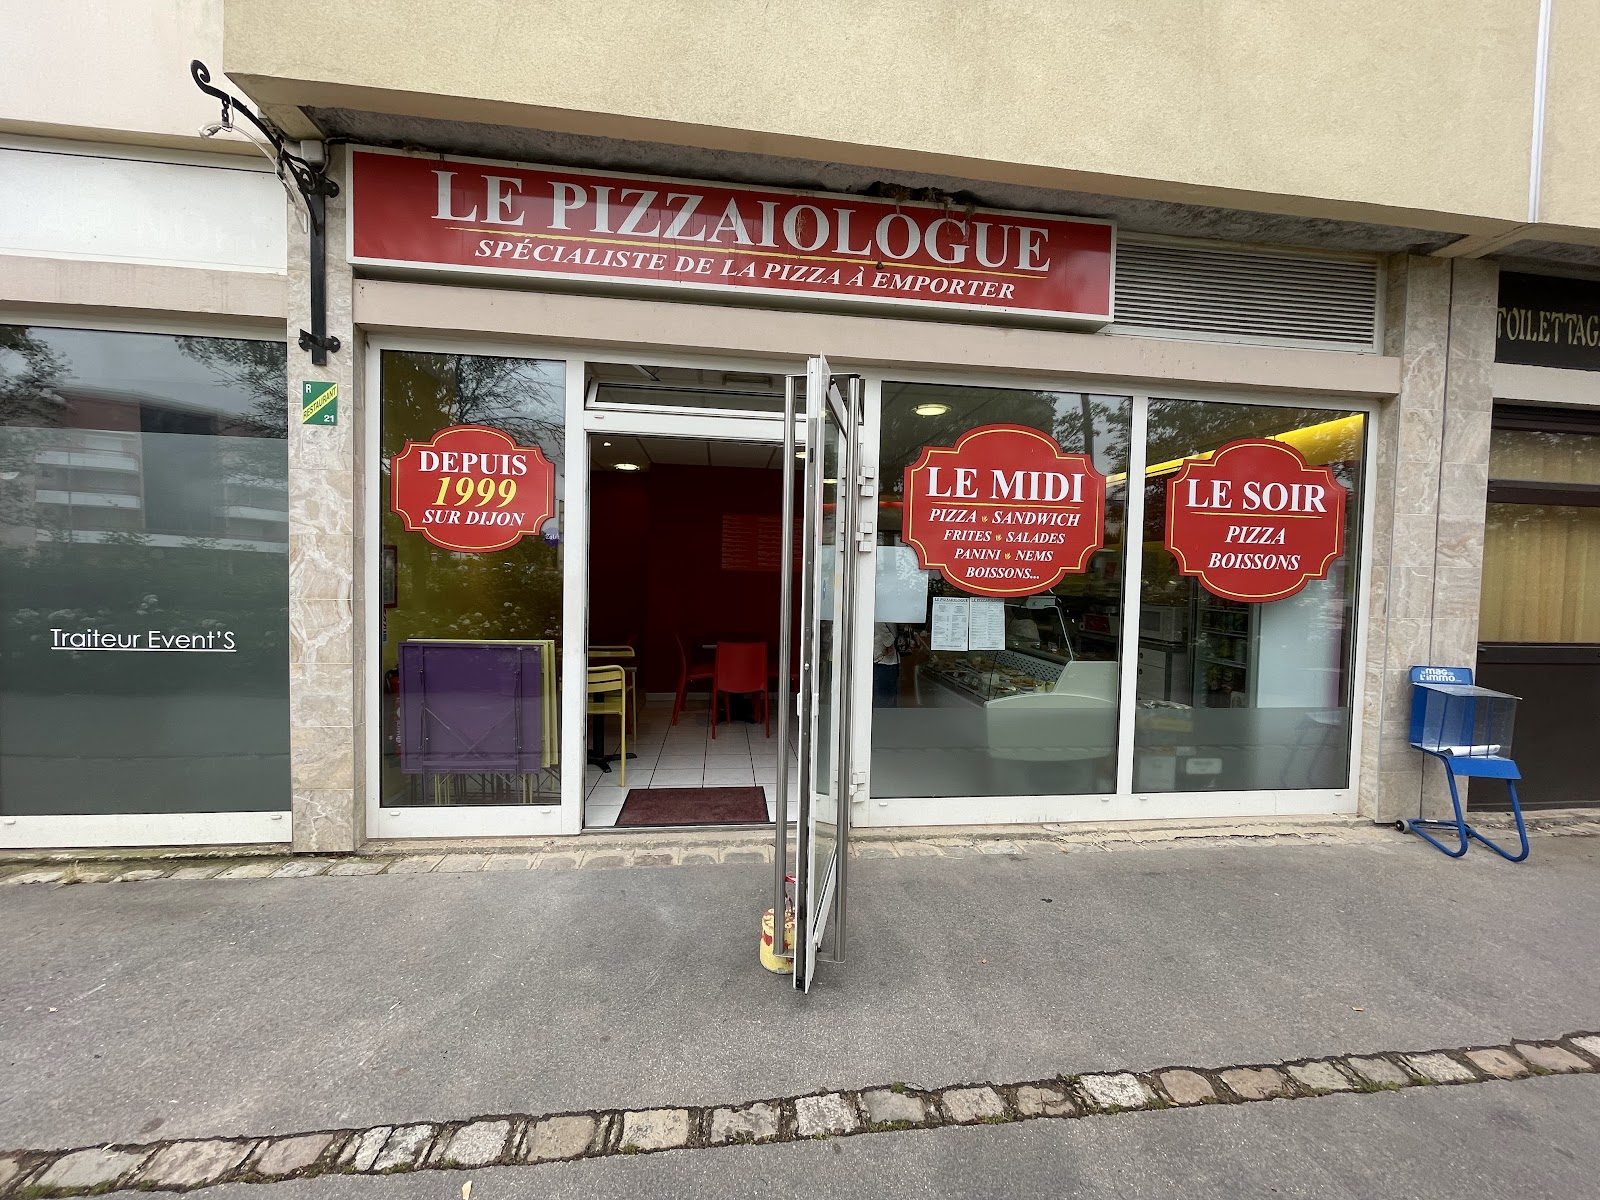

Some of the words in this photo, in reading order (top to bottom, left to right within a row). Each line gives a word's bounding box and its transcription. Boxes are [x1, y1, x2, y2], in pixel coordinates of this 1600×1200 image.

[431, 170, 525, 226] LE
[547, 181, 1050, 272] PIZZAIOLOGUE
[475, 239, 667, 271] SPÉCIALISTE
[673, 255, 714, 275] DE
[720, 259, 755, 278] LA
[763, 262, 840, 285] PIZZA
[846, 266, 865, 287] À
[871, 273, 1015, 300] EMPORTER
[1497, 307, 1600, 347] TOILETTAG
[305, 383, 312, 393] R
[303, 386, 337, 419] RESTAURANT
[323, 414, 335, 422] 21
[418, 450, 527, 475] DEPUIS
[432, 476, 517, 508] 1999
[925, 467, 978, 498] LE
[989, 469, 1085, 503] MIDI
[1185, 478, 1232, 509] LE
[1242, 481, 1327, 513] SOIR
[422, 509, 461, 525] SUR
[464, 511, 525, 526] DIJON
[928, 509, 977, 523] PIZZA
[992, 511, 1081, 527] SANDWICH
[943, 530, 992, 542] FRITES
[1006, 531, 1065, 544] SALADES
[1225, 525, 1286, 545] PIZZA
[954, 549, 1001, 560] PANINI
[1014, 550, 1054, 562] NEMS
[1208, 552, 1301, 571] BOISSONS
[50, 628, 141, 648] Traiteur
[149, 630, 235, 650] Event'S
